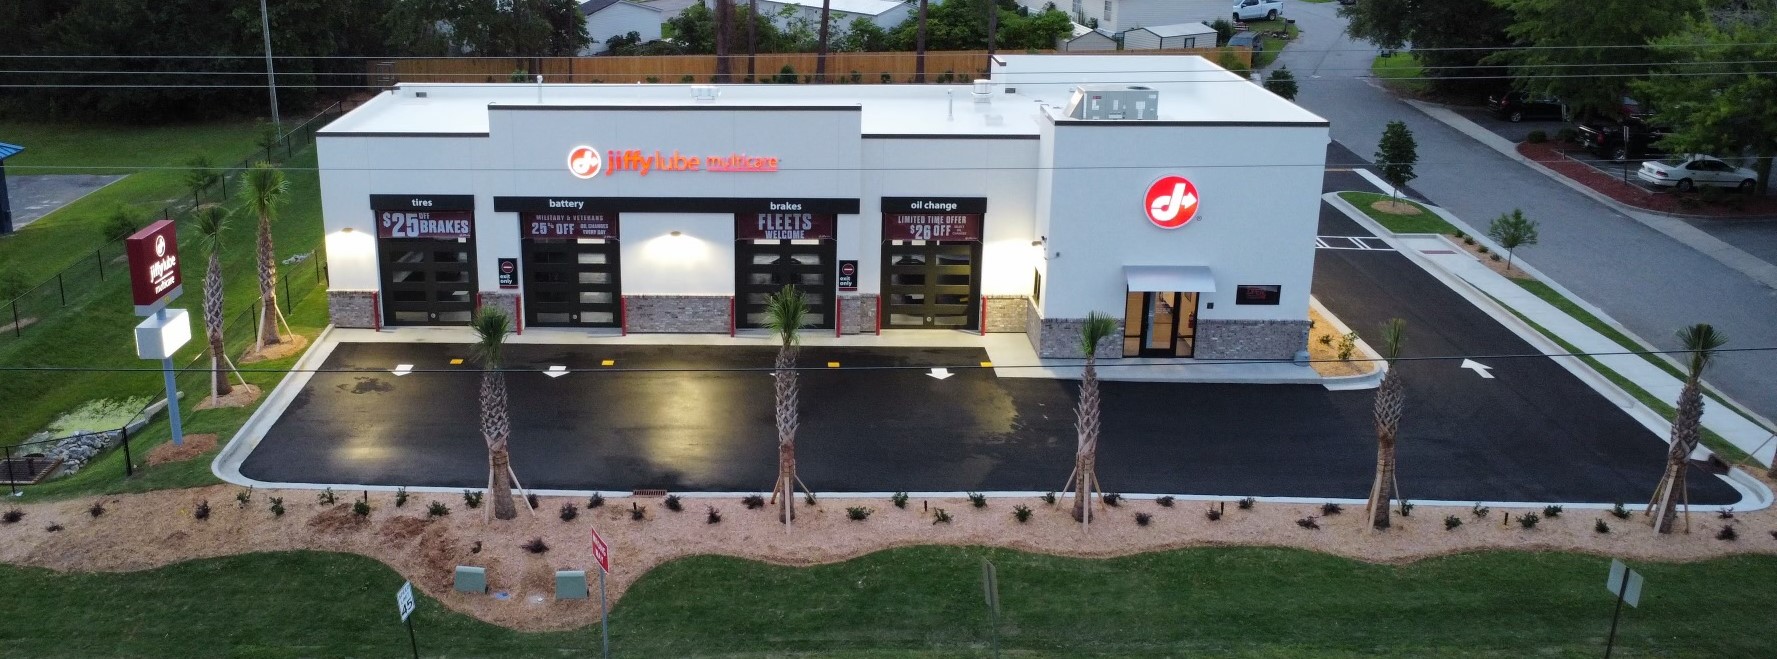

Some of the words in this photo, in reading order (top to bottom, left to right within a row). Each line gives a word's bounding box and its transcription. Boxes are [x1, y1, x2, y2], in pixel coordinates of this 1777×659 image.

[707, 153, 778, 168] multicare
[411, 198, 432, 207] tires
[549, 198, 584, 210] battery
[770, 202, 802, 211] brakes
[910, 201, 922, 209] oil
[924, 201, 957, 211] change
[383, 212, 420, 238] $25
[419, 212, 430, 220] OFF
[758, 213, 812, 230] FLEETS
[898, 215, 926, 224] LIMITED
[928, 215, 944, 224] TIME
[946, 215, 967, 224] OFFER
[420, 219, 469, 234] BRAKES
[556, 223, 575, 235] OFF
[933, 225, 951, 236] OFF
[765, 230, 805, 239] WELCOME
[402, 597, 413, 616] 45
